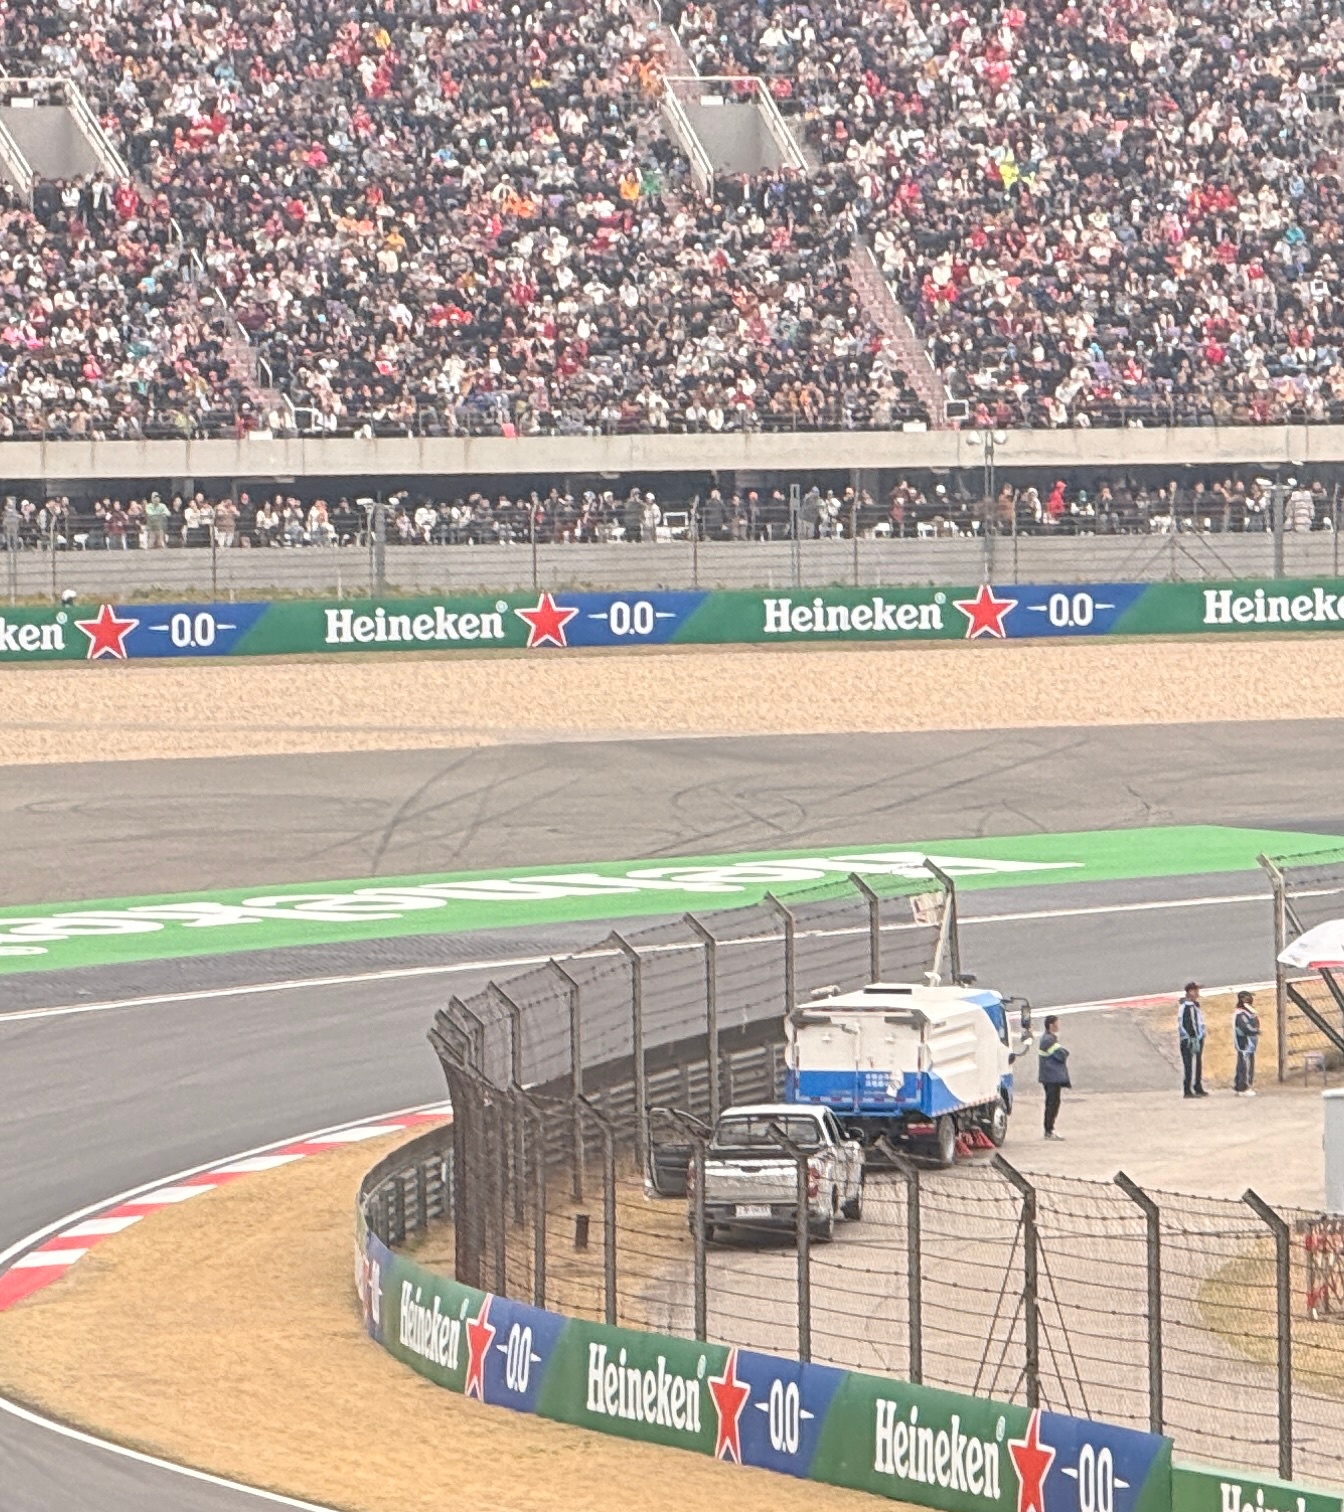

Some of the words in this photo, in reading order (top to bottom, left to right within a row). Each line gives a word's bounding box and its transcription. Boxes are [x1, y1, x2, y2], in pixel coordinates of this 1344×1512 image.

[325, 606, 505, 643] Heineken
[763, 597, 943, 633] Heineken
[400, 1279, 459, 1371] Heineken
[587, 1342, 702, 1433] Heineken
[875, 1398, 1001, 1500] Heineken
